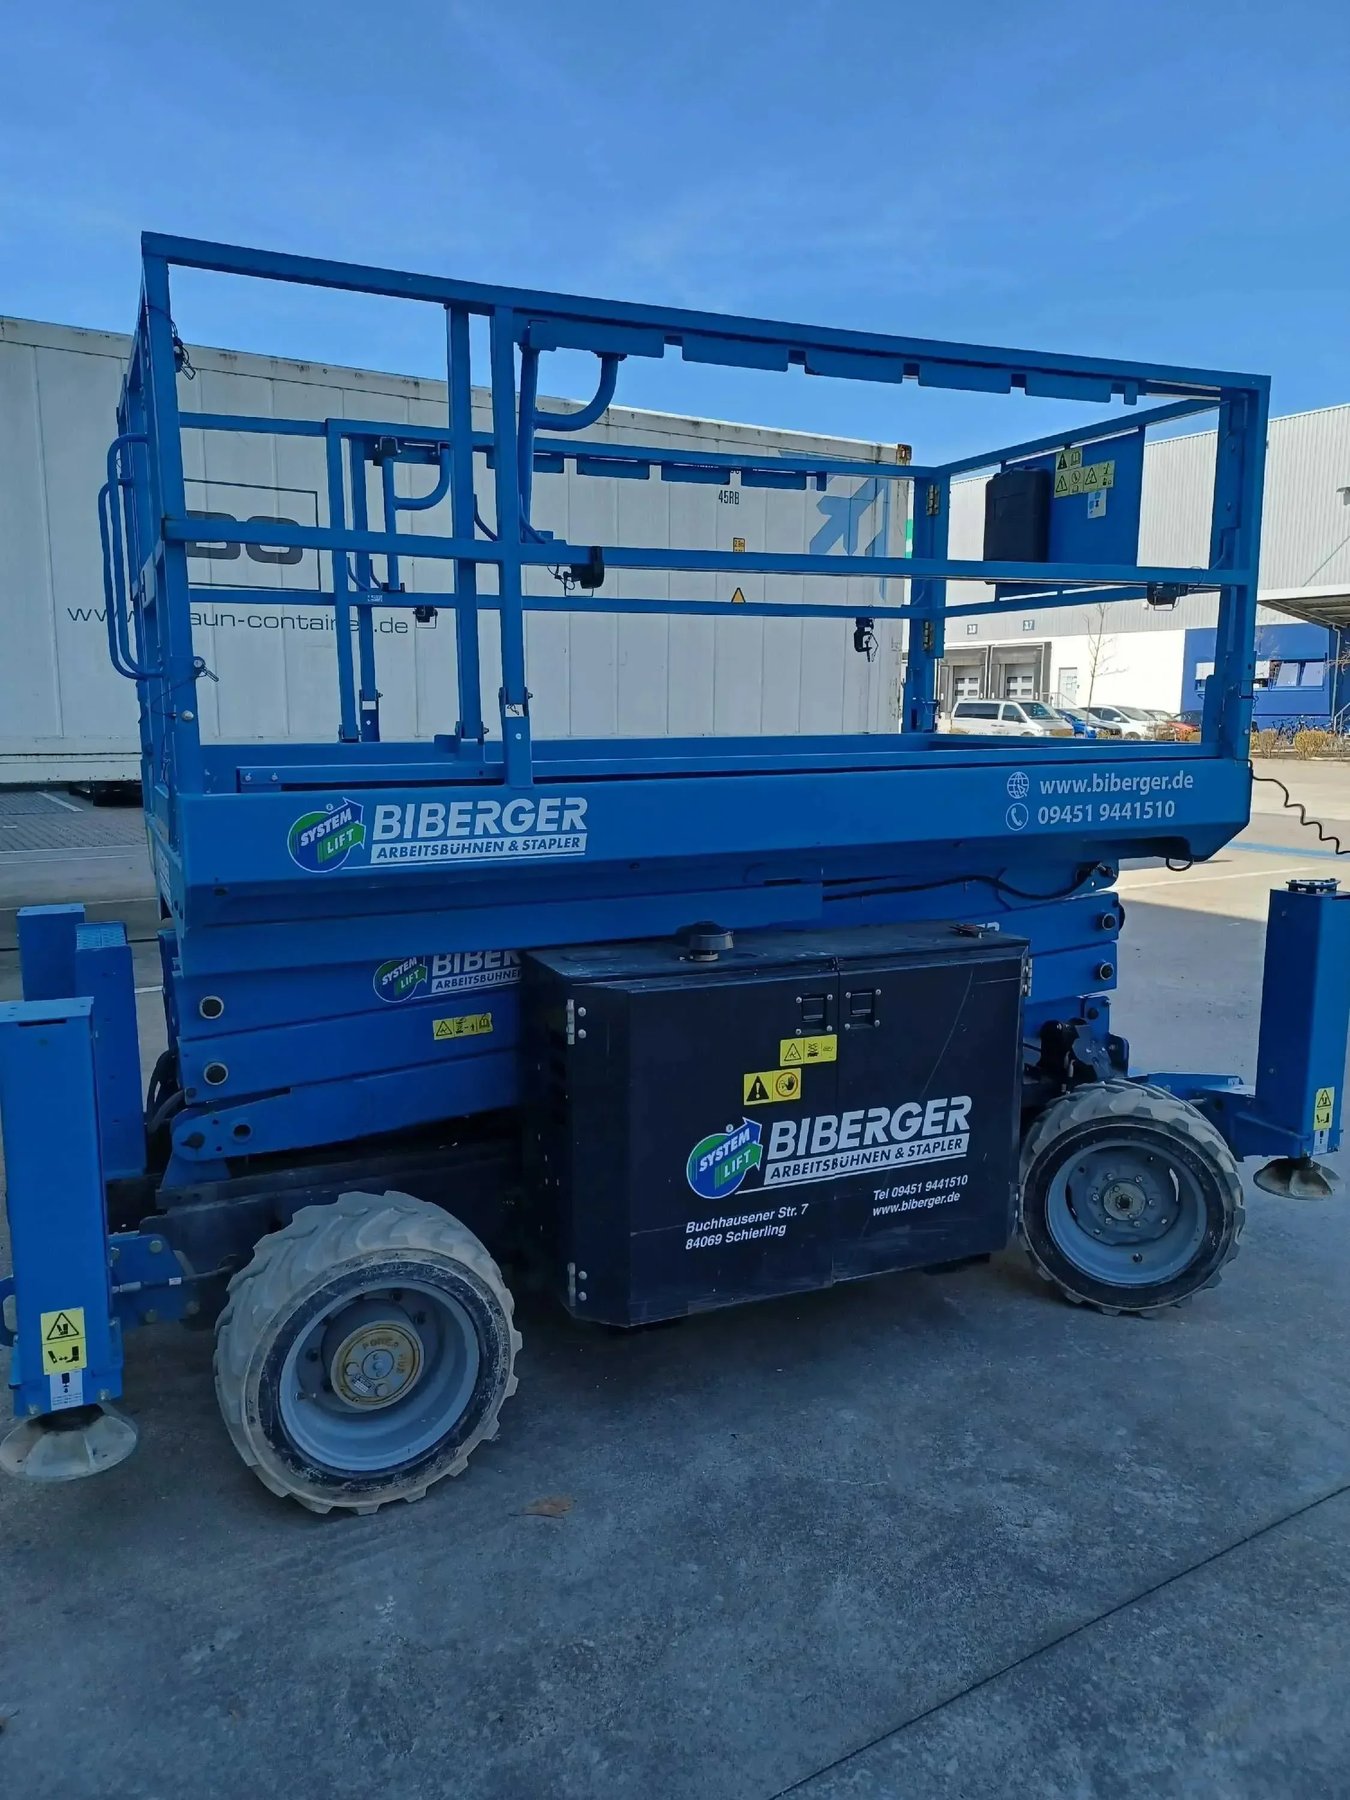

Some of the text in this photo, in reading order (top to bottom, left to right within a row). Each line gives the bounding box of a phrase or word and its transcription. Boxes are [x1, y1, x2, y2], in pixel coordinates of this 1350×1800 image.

[718, 489, 740, 505] 45RB
[1039, 770, 1194, 795] www.biberger.de
[372, 797, 588, 840] BIBERGER
[1037, 800, 1176, 825] 09451 9441510
[300, 808, 352, 847] SYSTEM
[327, 828, 354, 854] LIFT
[376, 836, 580, 859] ARBEITSBÜHNEN & STAPLER
[382, 956, 418, 986] SYSTEM
[400, 969, 419, 989] LIFT
[767, 1095, 972, 1160] BIBERGER
[699, 1127, 751, 1172] SYSTEM
[770, 1138, 963, 1180] ARBEITSBÜHNEN & STAPLER
[724, 1149, 751, 1178] LIFT
[873, 1174, 968, 1201] Tel 09451 9441510
[872, 1191, 960, 1217] www.biberger.de
[685, 1203, 809, 1234] Buchhausener Str. 7
[685, 1225, 787, 1250] 84069 Schierling
